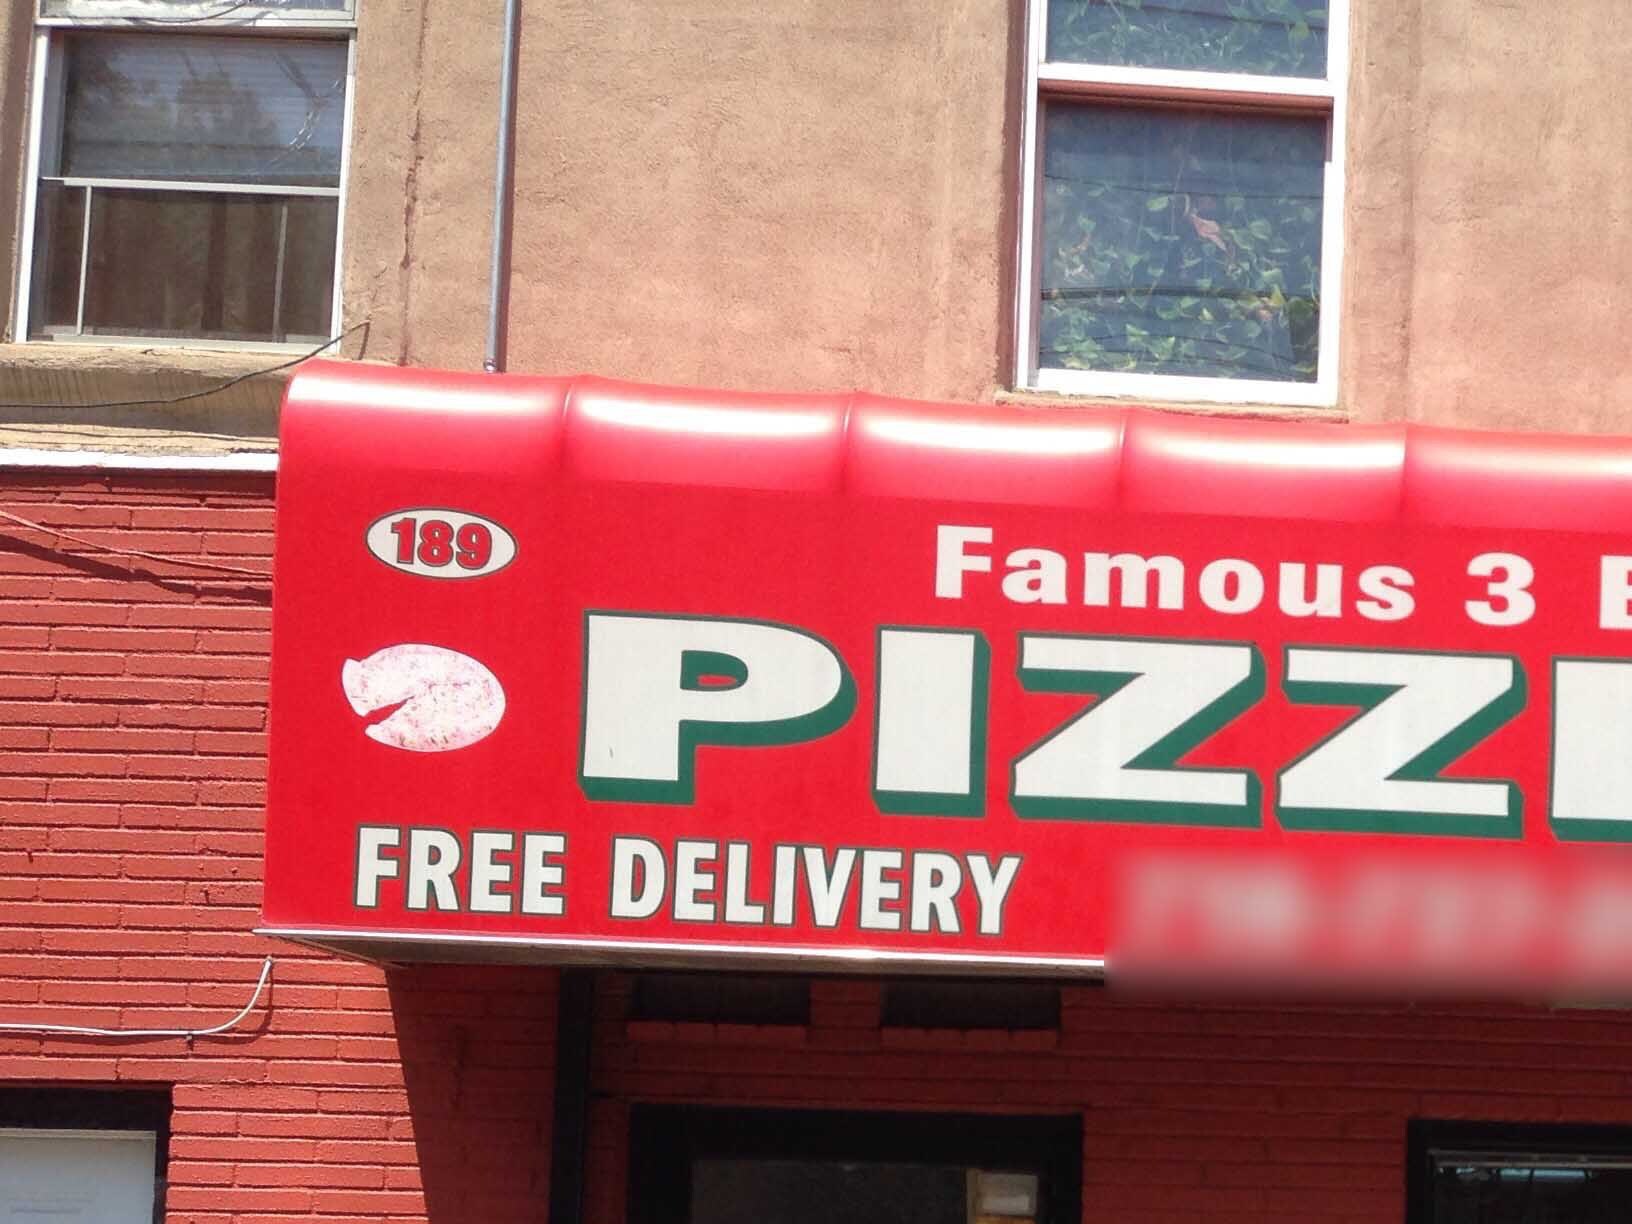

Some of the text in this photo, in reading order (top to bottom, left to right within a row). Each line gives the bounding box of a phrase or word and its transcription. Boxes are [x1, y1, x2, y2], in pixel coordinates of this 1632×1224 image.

[391, 517, 493, 571] 189
[934, 524, 1417, 622] Famous
[1463, 551, 1537, 627] 3
[352, 826, 569, 917] FREE
[608, 836, 1025, 936] DELIVERY
